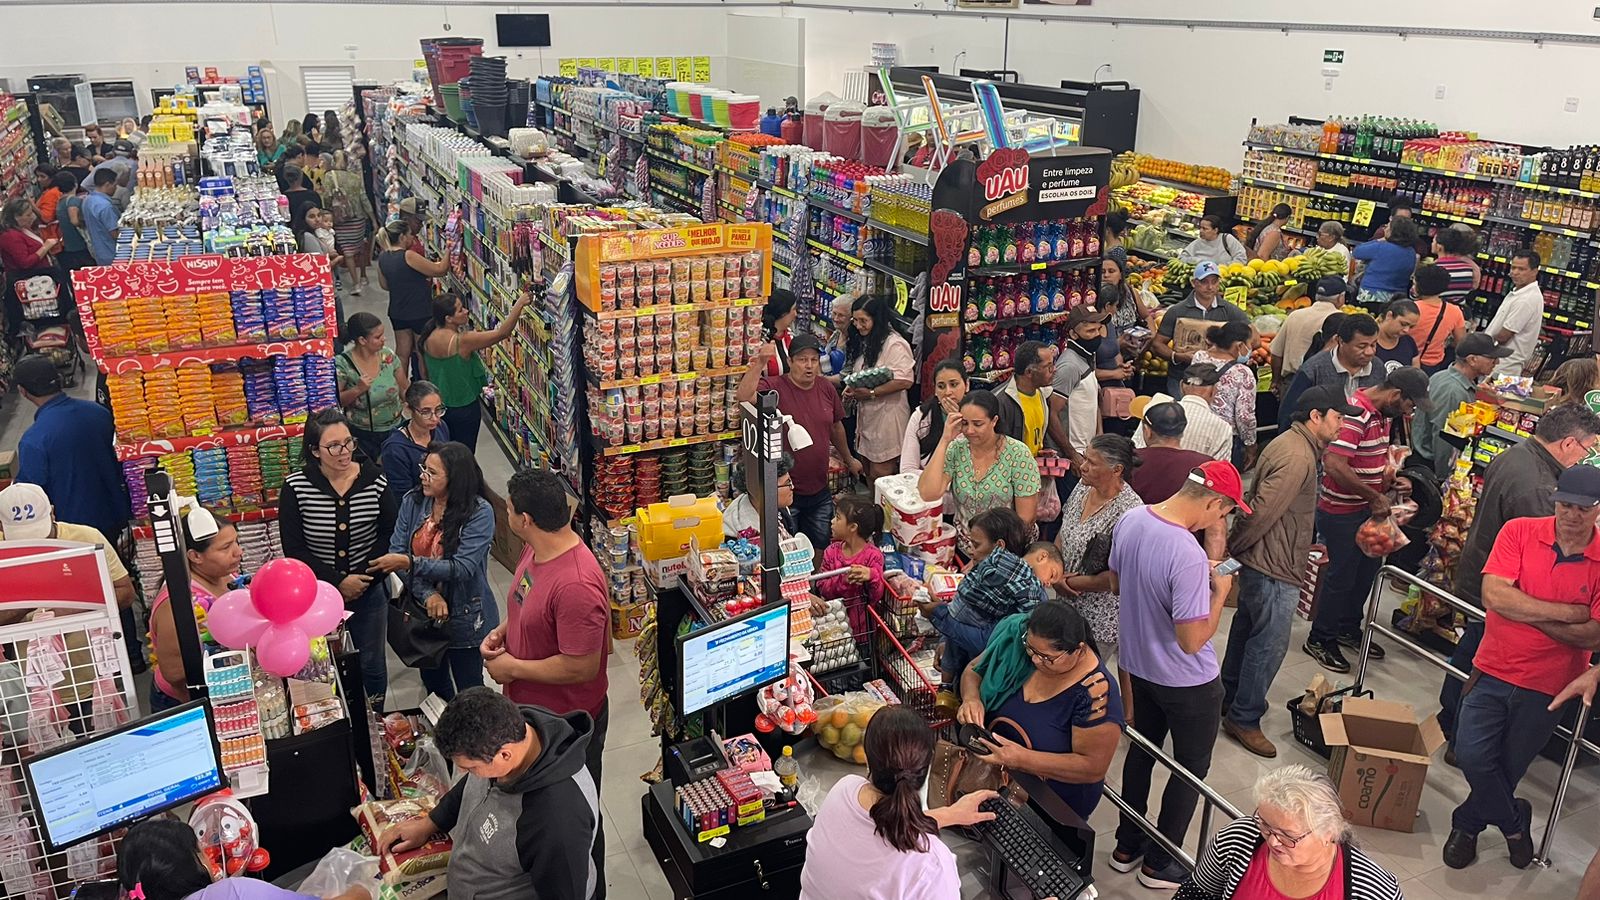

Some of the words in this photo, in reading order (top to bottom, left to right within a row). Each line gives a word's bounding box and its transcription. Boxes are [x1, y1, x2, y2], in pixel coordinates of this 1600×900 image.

[1043, 168, 1063, 177] Entre
[1065, 166, 1093, 176] limpeza
[985, 165, 1029, 201] UAU
[1049, 178, 1080, 189] perfume
[1041, 191, 1068, 199] ESCOLHA
[986, 195, 1025, 218] perfumes
[661, 232, 679, 241] CUP
[691, 227, 717, 238] MELHOR
[731, 233, 751, 241] PANELA
[653, 239, 686, 250] NOODLES
[701, 236, 720, 246] MIOJO
[186, 259, 218, 269] NISSIN
[930, 282, 961, 311] UAU
[743, 418, 759, 458] 02
[12, 504, 35, 520] 22
[1358, 767, 1377, 809] coamo
